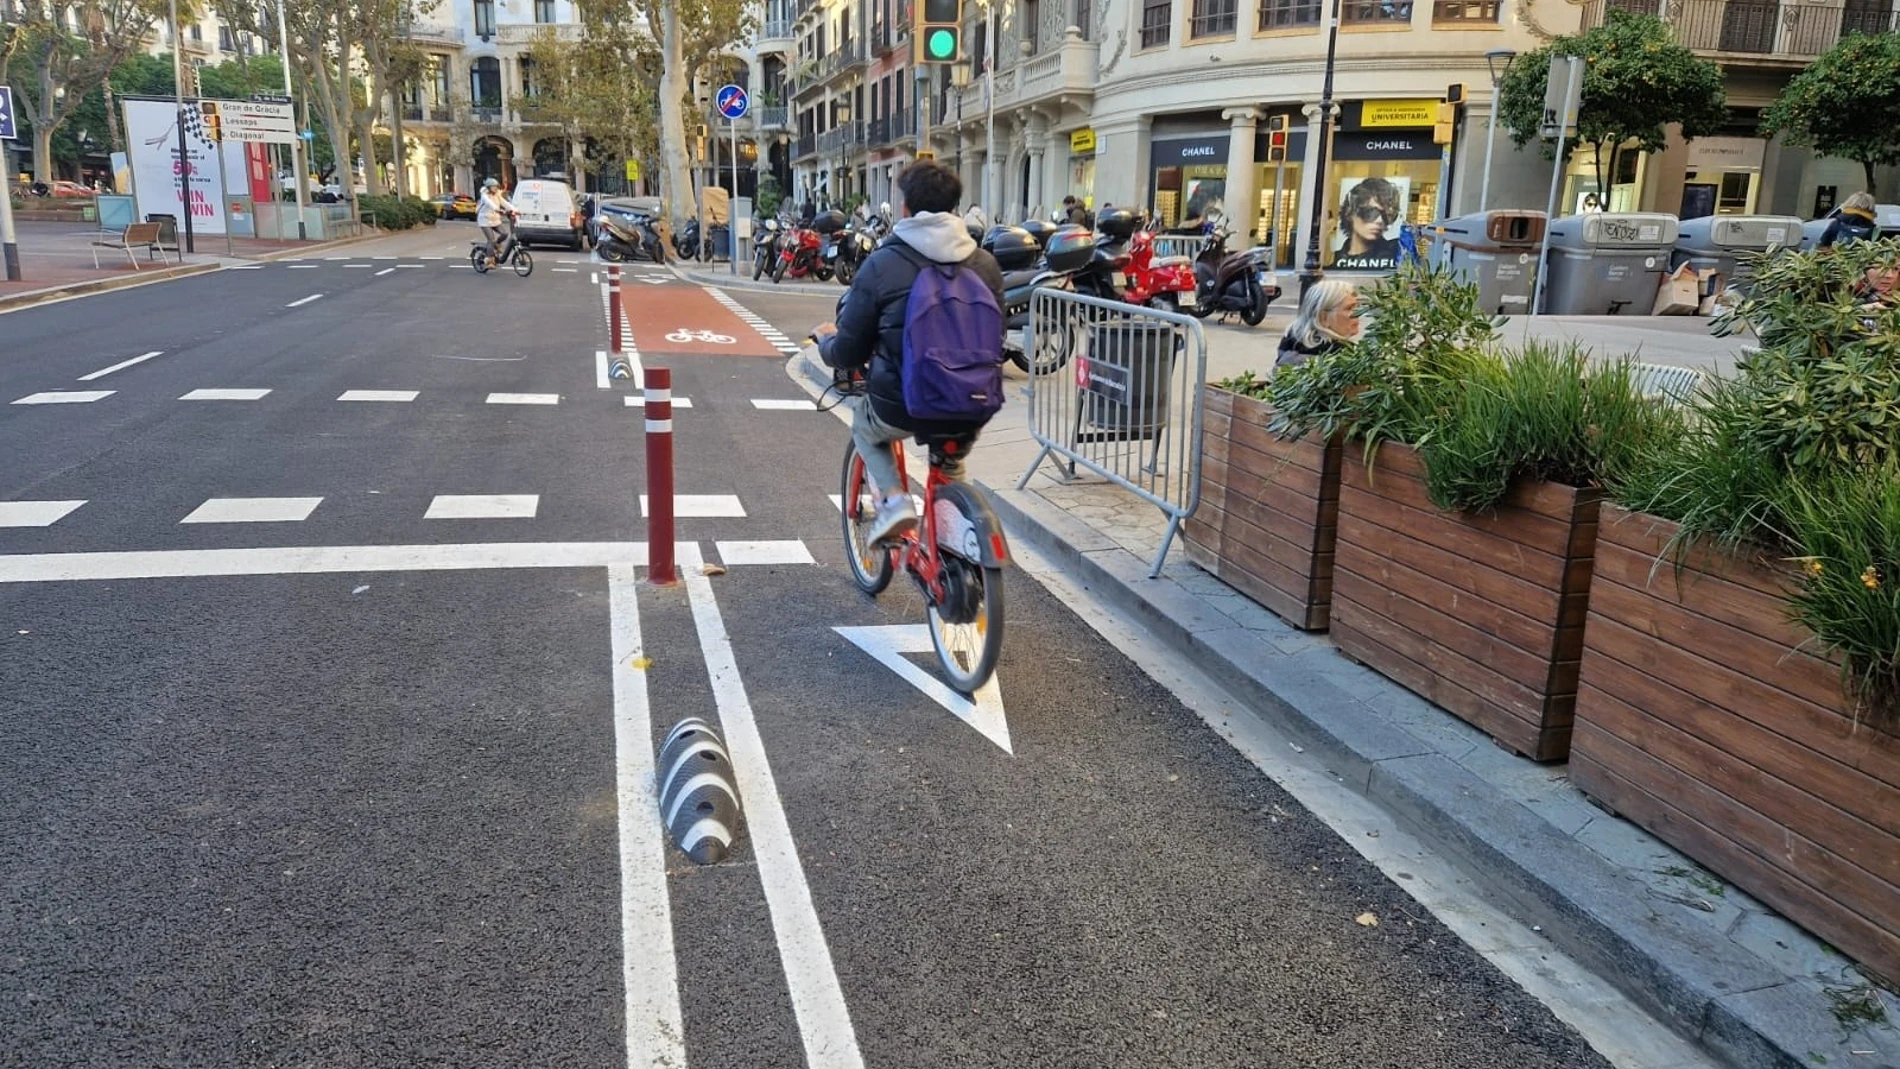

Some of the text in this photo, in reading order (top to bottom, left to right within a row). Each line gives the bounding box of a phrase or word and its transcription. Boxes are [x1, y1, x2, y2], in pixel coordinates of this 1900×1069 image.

[222, 102, 241, 111] Gran
[243, 103, 253, 112] de
[1371, 112, 1429, 121] UNIVERSITARIA
[225, 117, 258, 126] Lesseps
[229, 131, 265, 140] Diagonal
[1366, 140, 1413, 150] CHANEL
[1181, 146, 1215, 157] CHANEL
